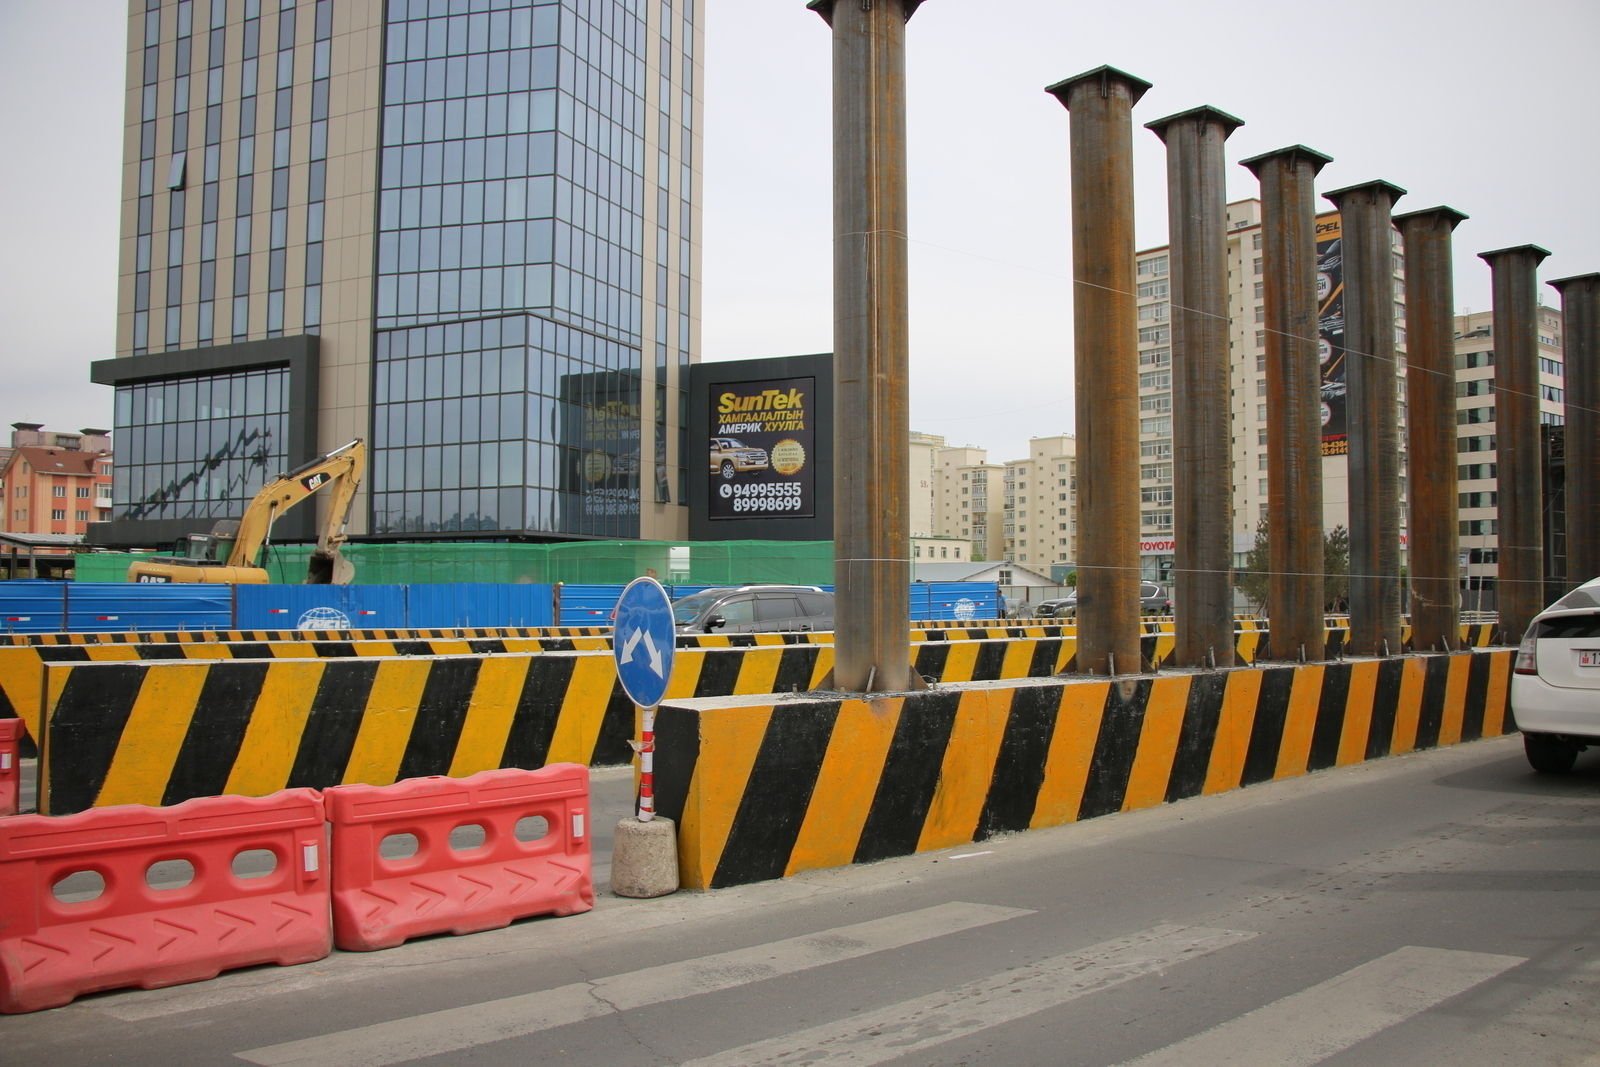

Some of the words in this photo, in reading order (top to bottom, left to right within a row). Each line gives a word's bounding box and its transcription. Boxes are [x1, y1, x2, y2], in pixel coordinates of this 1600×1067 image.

[718, 389, 804, 413] SunTek
[718, 410, 804, 424] ХАМГААЛАЛТЫН
[718, 422, 762, 434] АМЕРИК
[764, 420, 804, 432] ХУУЛГА
[308, 474, 322, 490] CAT
[733, 482, 802, 498] 94995555
[733, 497, 802, 512] 89998699
[1139, 541, 1176, 551] TOYOTA
